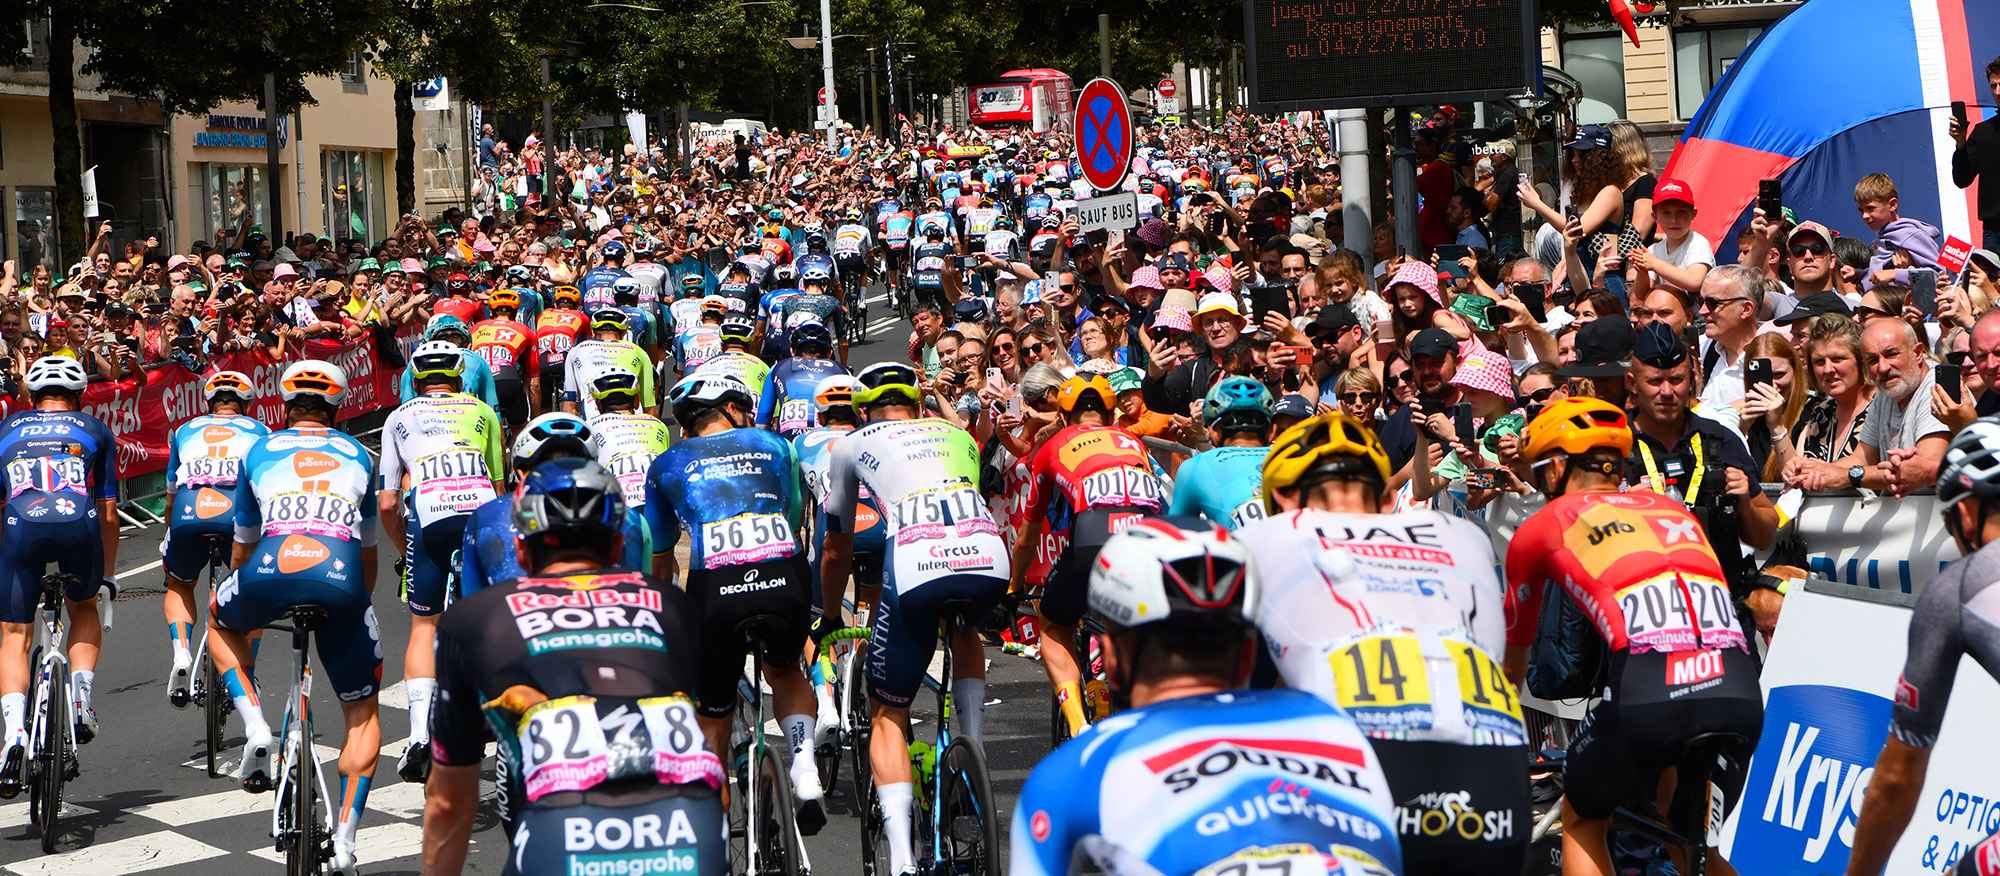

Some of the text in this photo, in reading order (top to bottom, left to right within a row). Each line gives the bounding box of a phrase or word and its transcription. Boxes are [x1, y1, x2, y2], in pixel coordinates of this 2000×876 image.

[1286, 42, 1308, 57] au
[1080, 203, 1133, 226] SAUF BUS
[11, 415, 85, 428] Groupama
[20, 424, 53, 437] FDJ
[186, 458, 237, 477] 185 18
[298, 459, 337, 469] postnl
[420, 453, 453, 481] 176
[700, 452, 772, 466] DECATHLON
[736, 461, 753, 469] LA
[858, 451, 881, 473] SITRA
[906, 450, 951, 461] FANTINI
[703, 467, 763, 481] MONDIALE
[439, 492, 478, 503] Circus
[1084, 473, 1125, 503] 201
[199, 499, 228, 508] postnl
[265, 496, 356, 527] 188 188
[896, 493, 940, 528] 175
[711, 515, 787, 553] 56 56
[1315, 523, 1443, 549] UAE
[283, 547, 324, 559] postnl
[405, 532, 416, 593] FANTINI
[917, 555, 994, 572] Intermarché
[929, 544, 980, 558] Circus
[719, 578, 787, 596] DECATHLON
[505, 588, 663, 617] Red Bull
[1623, 578, 1689, 635] 204
[516, 606, 665, 640] BORA
[534, 628, 664, 653] hansgrohe
[870, 600, 892, 681] FANTINI
[1345, 640, 1513, 711] 14 14
[1673, 649, 1723, 685] MOT
[529, 709, 591, 767] 82
[1163, 749, 1373, 794] SOUDAL
[564, 808, 698, 852] BORA
[568, 849, 696, 876] hansgrohe
